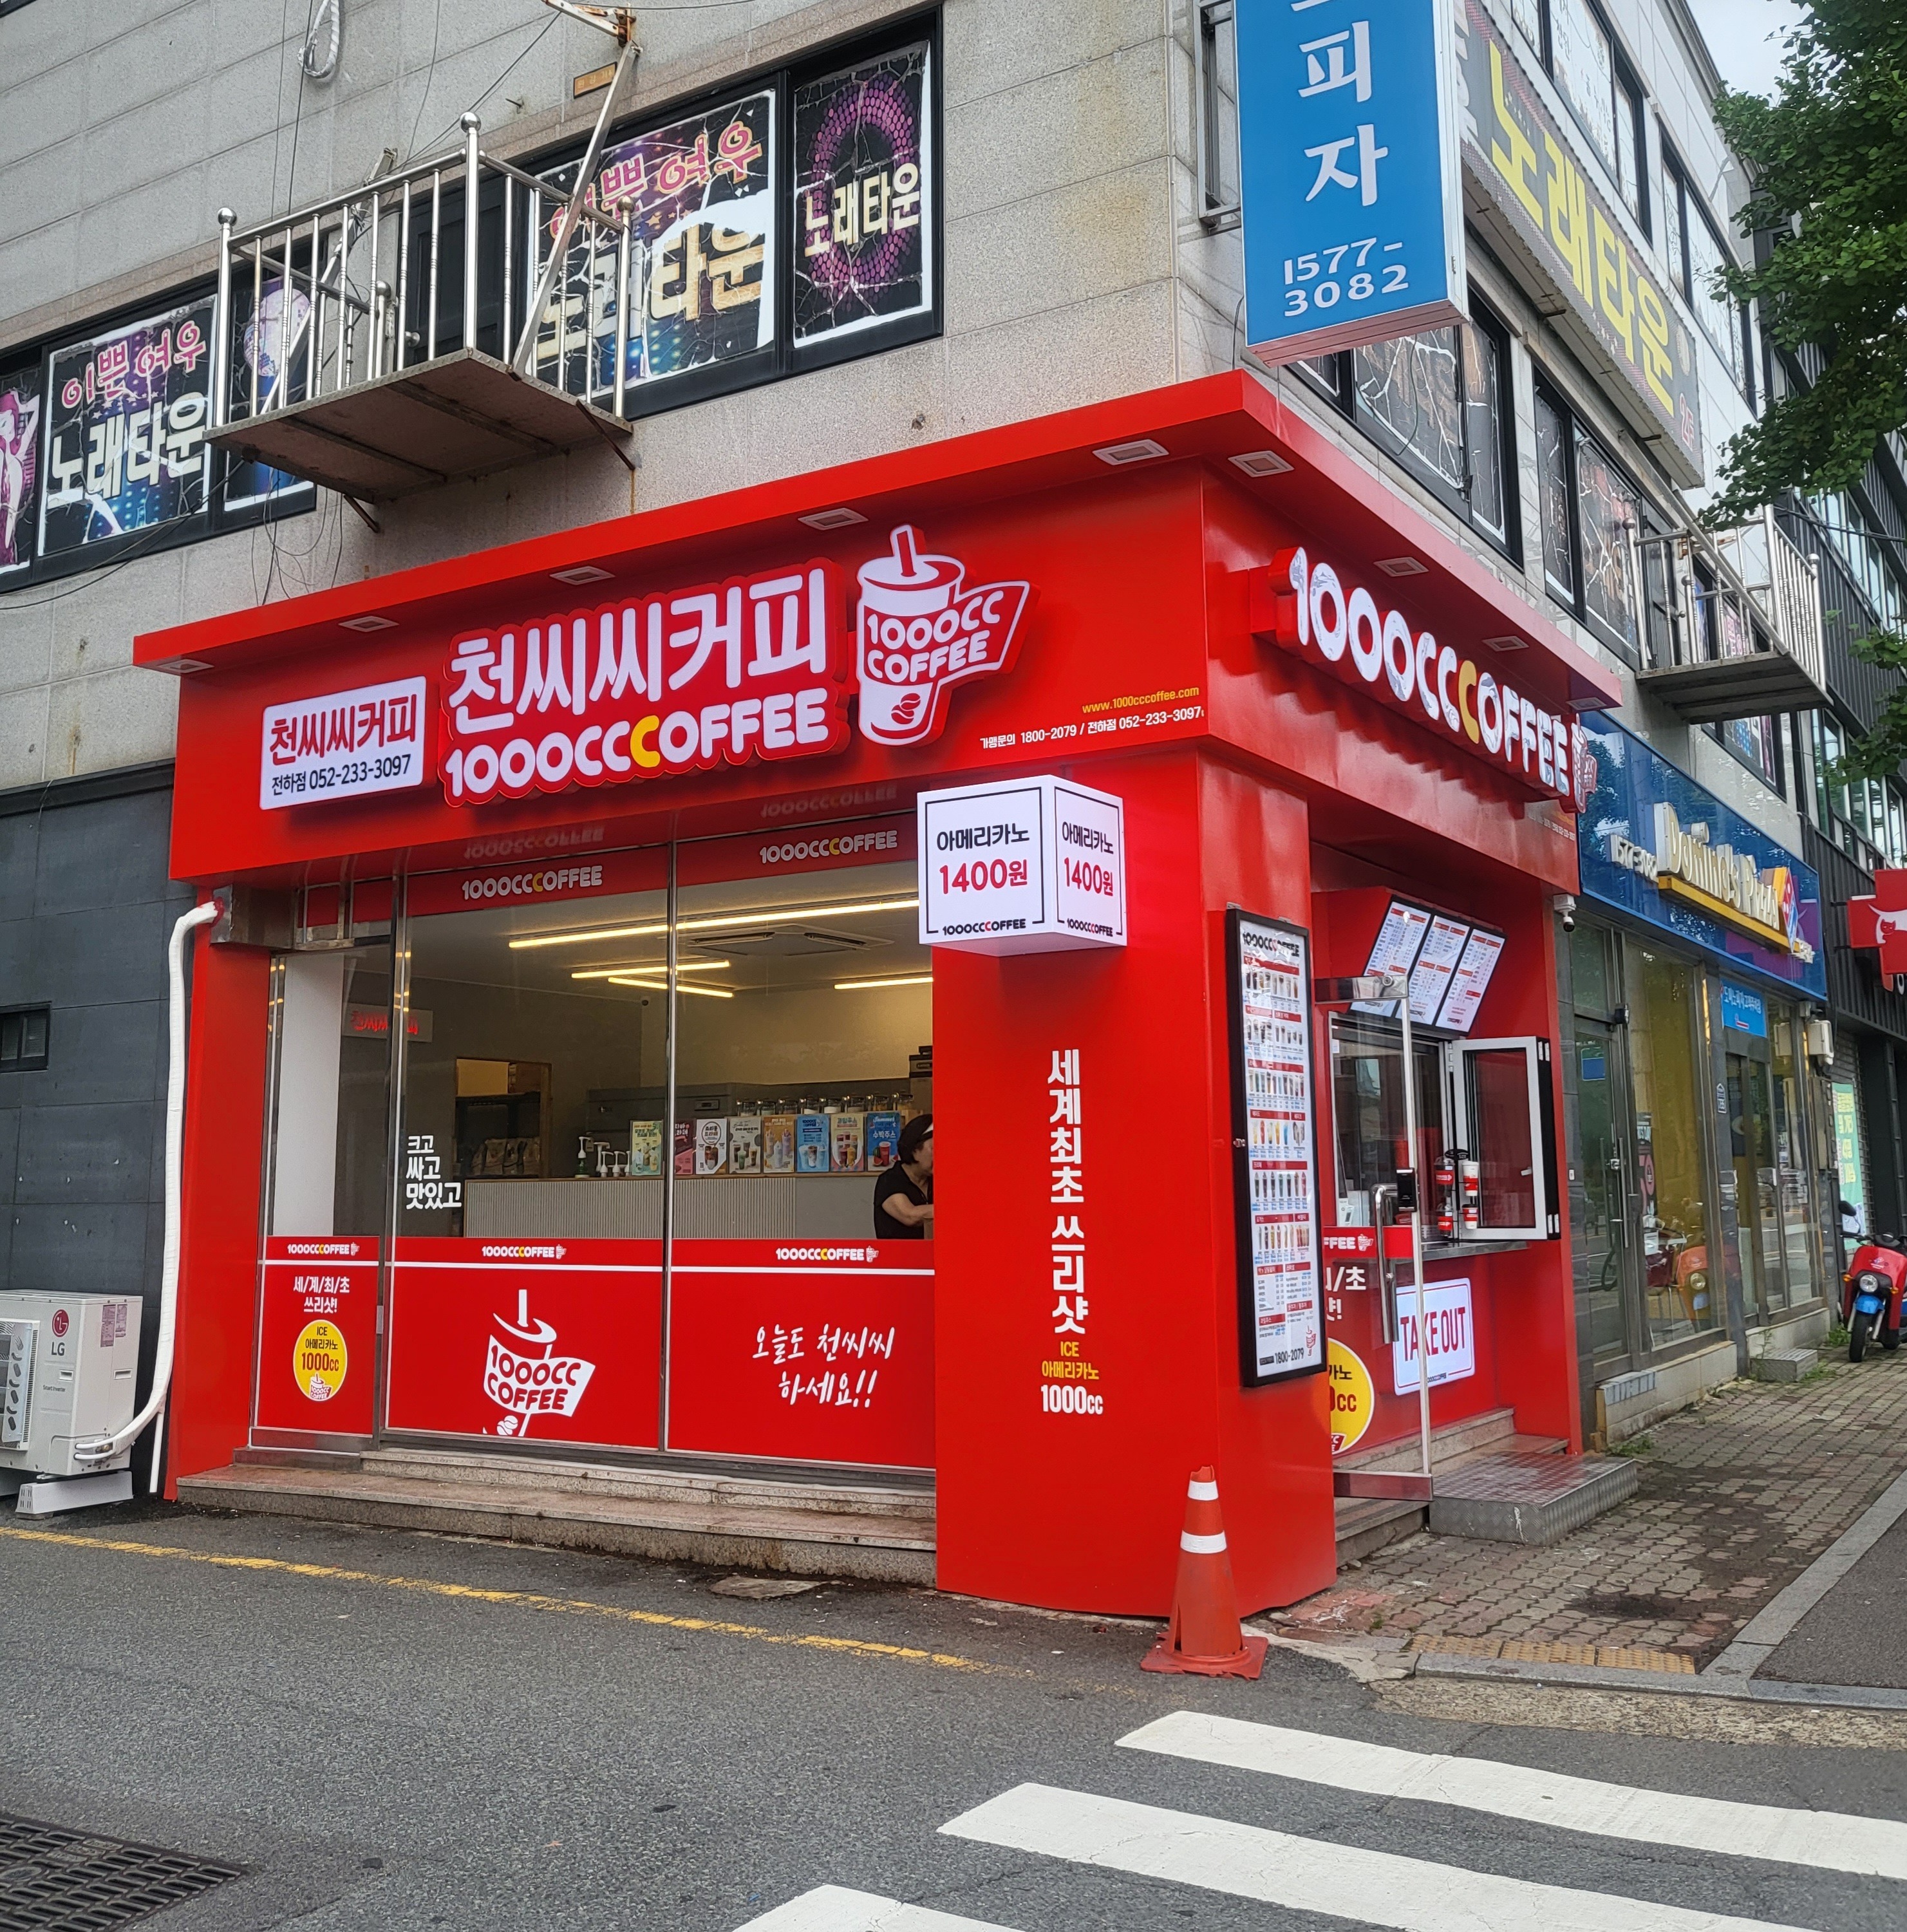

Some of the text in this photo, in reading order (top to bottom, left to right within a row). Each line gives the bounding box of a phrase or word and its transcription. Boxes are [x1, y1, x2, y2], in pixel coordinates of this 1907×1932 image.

[1290, 0, 1389, 207] 피자
[805, 162, 920, 257] 노래타운
[1489, 39, 1675, 420] 노래타운
[1283, 265, 1409, 317] 3082
[52, 392, 208, 500] 노래타운
[867, 590, 1004, 650] 1000CC
[449, 568, 827, 735] 천씨씨커피
[867, 630, 990, 683] COFFEE
[1289, 546, 1570, 797] 1000CCCOFFEE
[1082, 686, 1199, 714] www.1000cccoffee.com
[269, 693, 417, 766] 천씨씨커피
[446, 686, 829, 797] 1000CCCOFFEE
[979, 733, 1016, 749] 가맹문의
[1020, 725, 1077, 744] 1800-2079
[1087, 719, 1117, 735] 전하점
[1118, 706, 1202, 730] 052-233-3097
[271, 753, 411, 796] 전하점 052-233-3097
[759, 829, 898, 865] 1000CCCOFFEE
[936, 822, 1030, 851] 아메리카노
[1062, 821, 1114, 855] 아메리카노
[461, 865, 603, 901] 1000CCCOFFEE
[939, 858, 1028, 895] 1400원
[1064, 856, 1114, 897] 1400원
[942, 918, 1027, 937] 1000CCCOFFEE
[1066, 917, 1114, 937] 1000CCCOFFEE
[407, 1134, 435, 1154] 크고
[872, 1130, 896, 1139] 수박주스
[1047, 1049, 1085, 1204] 세계최초
[406, 1156, 441, 1181] 싸고
[406, 1182, 462, 1210] 맛있고
[287, 1243, 350, 1255] 1000CCCOFFEE
[481, 1246, 555, 1259] 1000CCCOFFEE
[775, 1248, 865, 1261] 1000CCCOFFEE
[293, 1275, 350, 1294] 세/계/최/초
[1051, 1215, 1089, 1335] 쓰리샷
[303, 1297, 338, 1314] 쓰리샷!
[305, 1338, 339, 1351] 아메리카노
[316, 1326, 328, 1336] ICE
[752, 1323, 896, 1365] 오늘도 천씨씨
[1441, 1306, 1466, 1354] OUT
[51, 1341, 66, 1356] LG
[301, 1351, 340, 1372] 1000cc
[491, 1344, 583, 1387] 1000CC
[1060, 1340, 1080, 1358] ICE
[1274, 1347, 1305, 1365] 1800-2079
[1041, 1359, 1100, 1380] 아메리카노
[487, 1375, 568, 1411] COFFEE
[778, 1369, 878, 1408] 하세요!!
[1040, 1383, 1104, 1415] 1000cc
